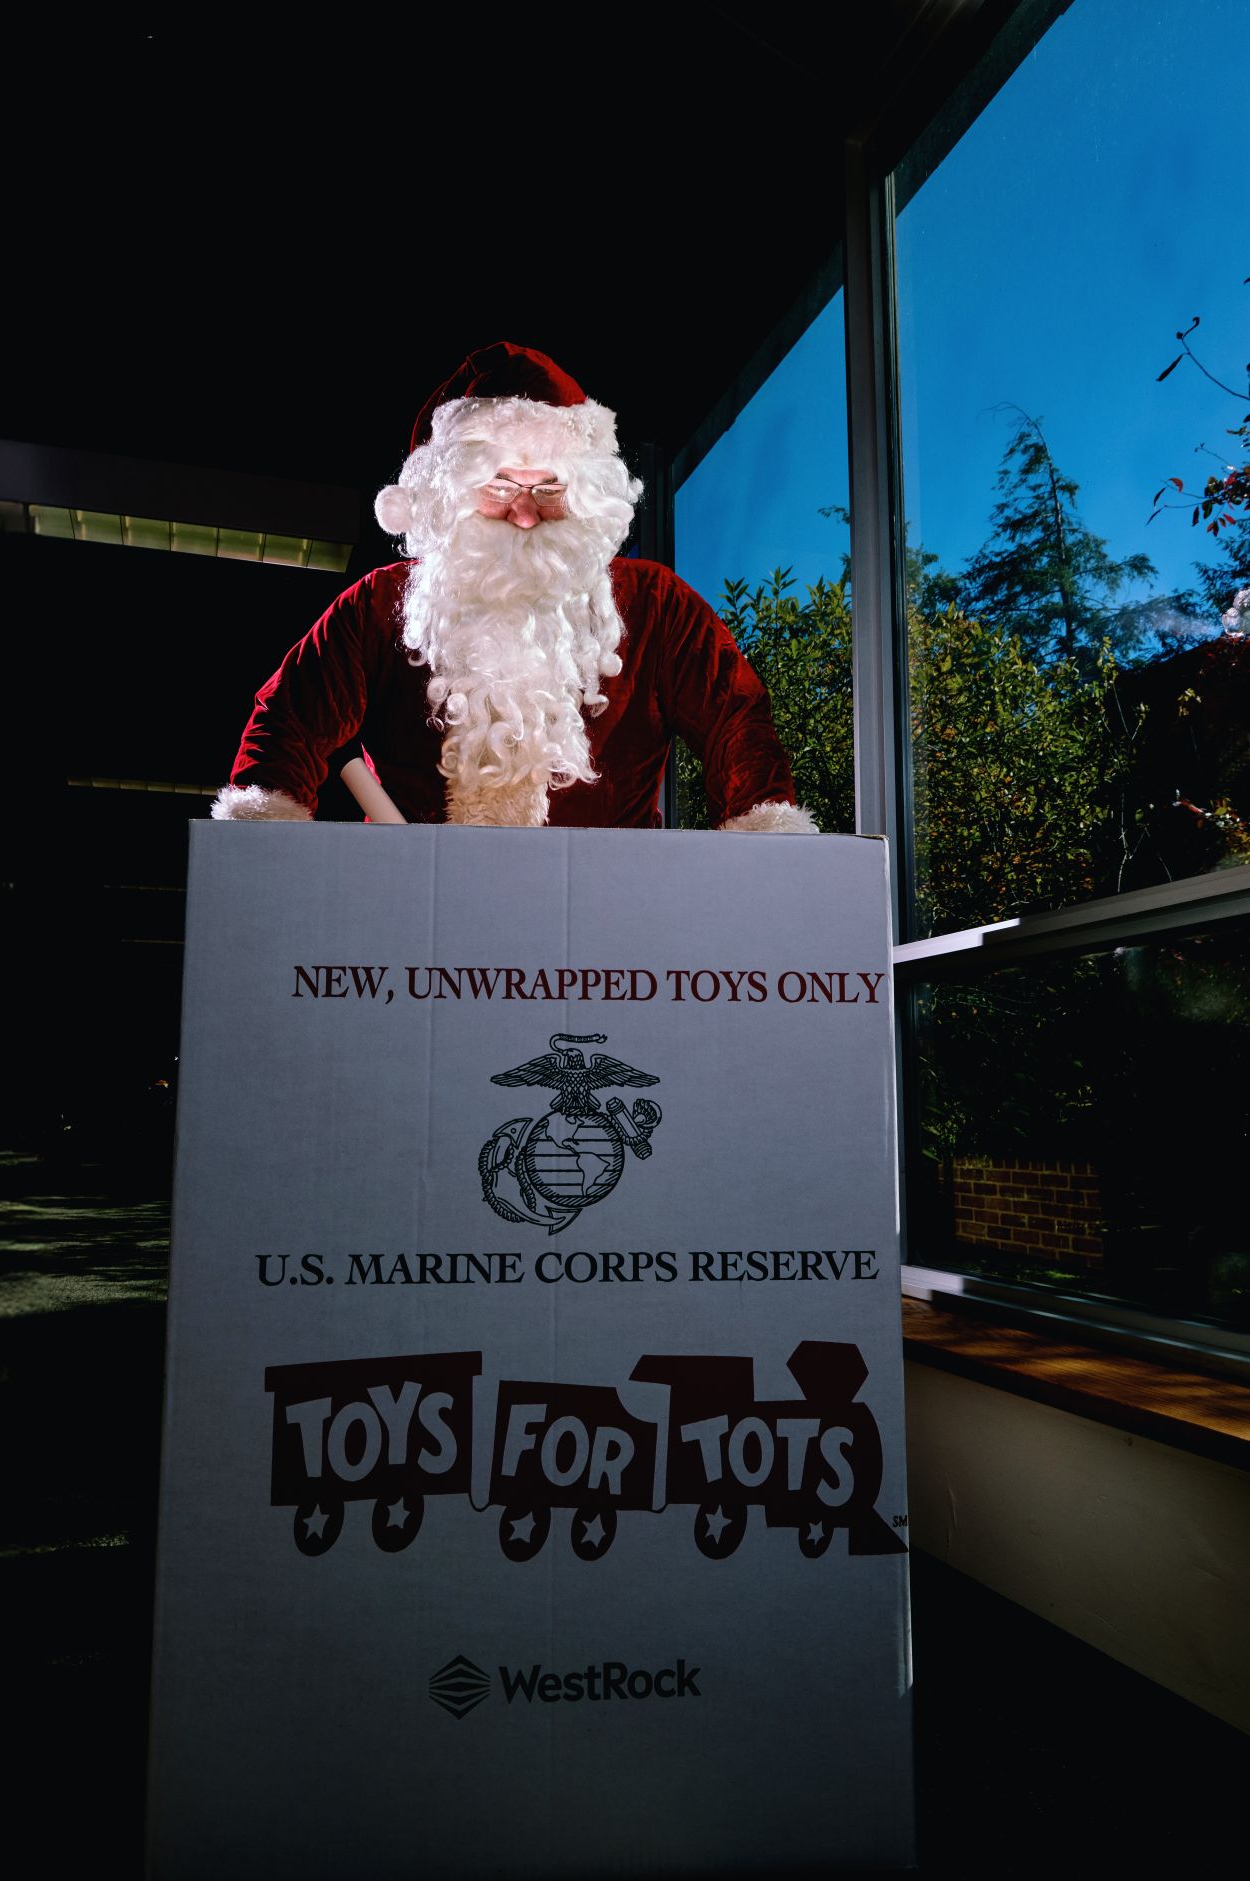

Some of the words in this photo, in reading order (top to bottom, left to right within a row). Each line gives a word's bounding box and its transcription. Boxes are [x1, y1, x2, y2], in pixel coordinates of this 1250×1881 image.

[292, 965, 395, 1005] NEW,
[405, 966, 658, 1001] UNWRAPPED
[667, 970, 768, 1003] TOYS
[777, 971, 885, 1004] ONLY
[255, 1254, 335, 1286] U.S.
[345, 1253, 525, 1285] MARINE
[534, 1251, 679, 1283] CORPS
[688, 1250, 880, 1282] RESERVE
[285, 1381, 458, 1483] TOYS
[501, 1403, 636, 1497] FOR
[680, 1415, 855, 1508] TOTS
[892, 1514, 908, 1528] SM
[498, 1659, 701, 1703] WestRock
